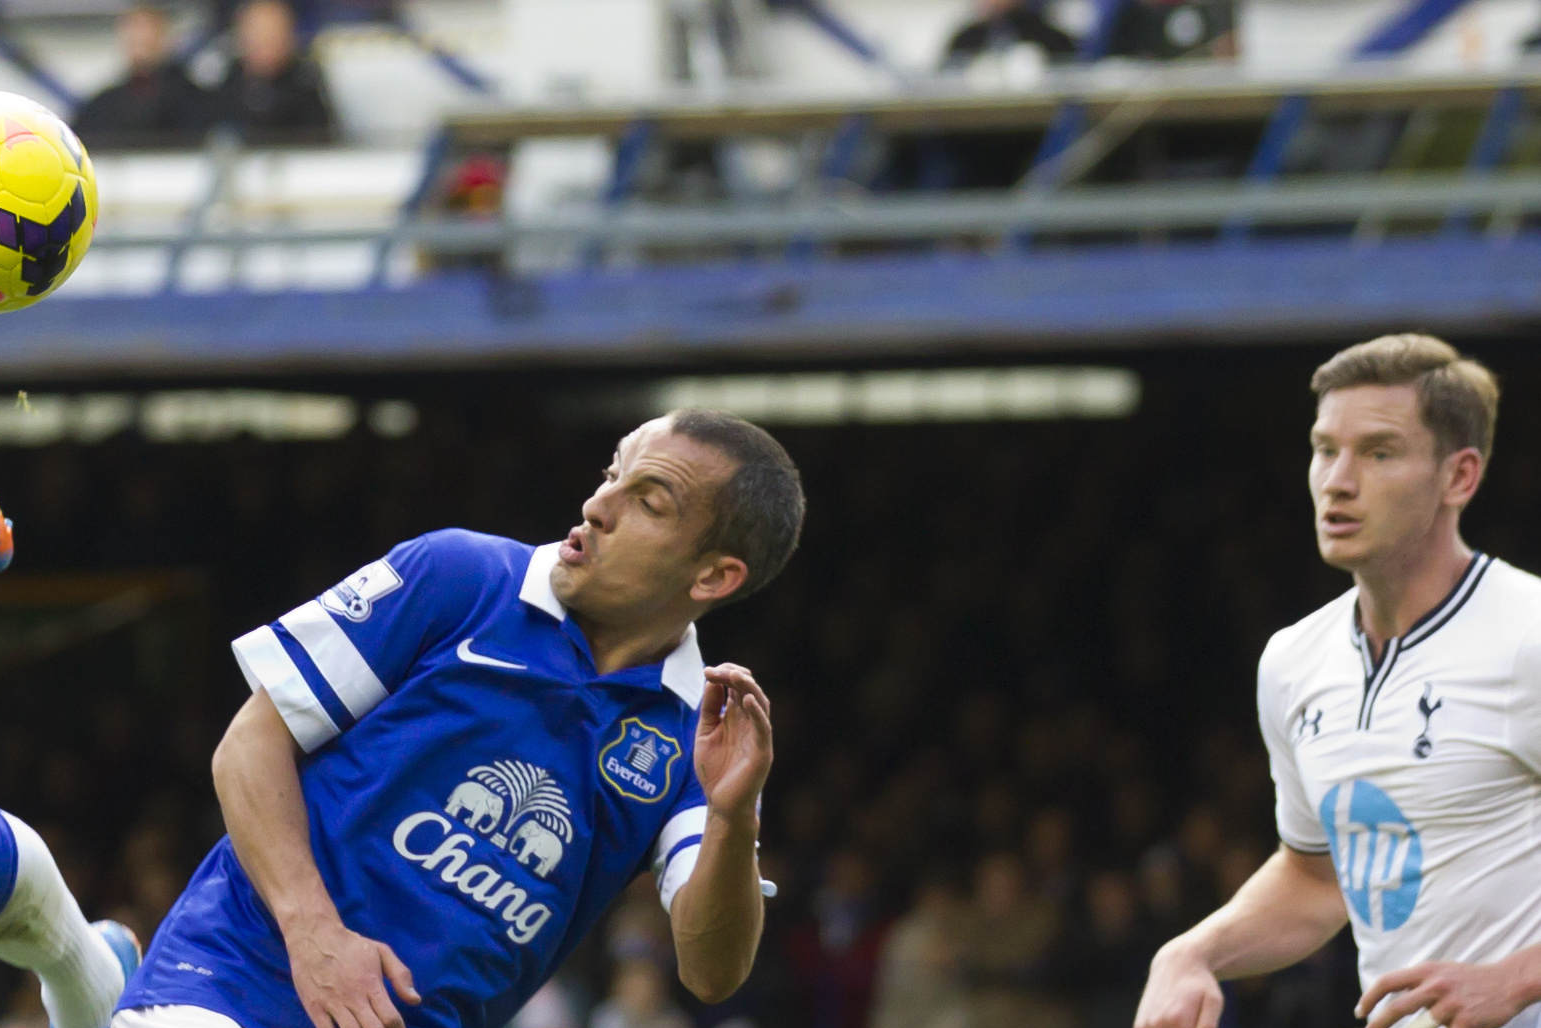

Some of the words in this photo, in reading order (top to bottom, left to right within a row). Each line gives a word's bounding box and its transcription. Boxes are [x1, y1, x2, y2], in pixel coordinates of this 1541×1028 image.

[606, 757, 656, 795] Everton
[393, 811, 552, 944] Chang
[1333, 781, 1412, 931] hp
